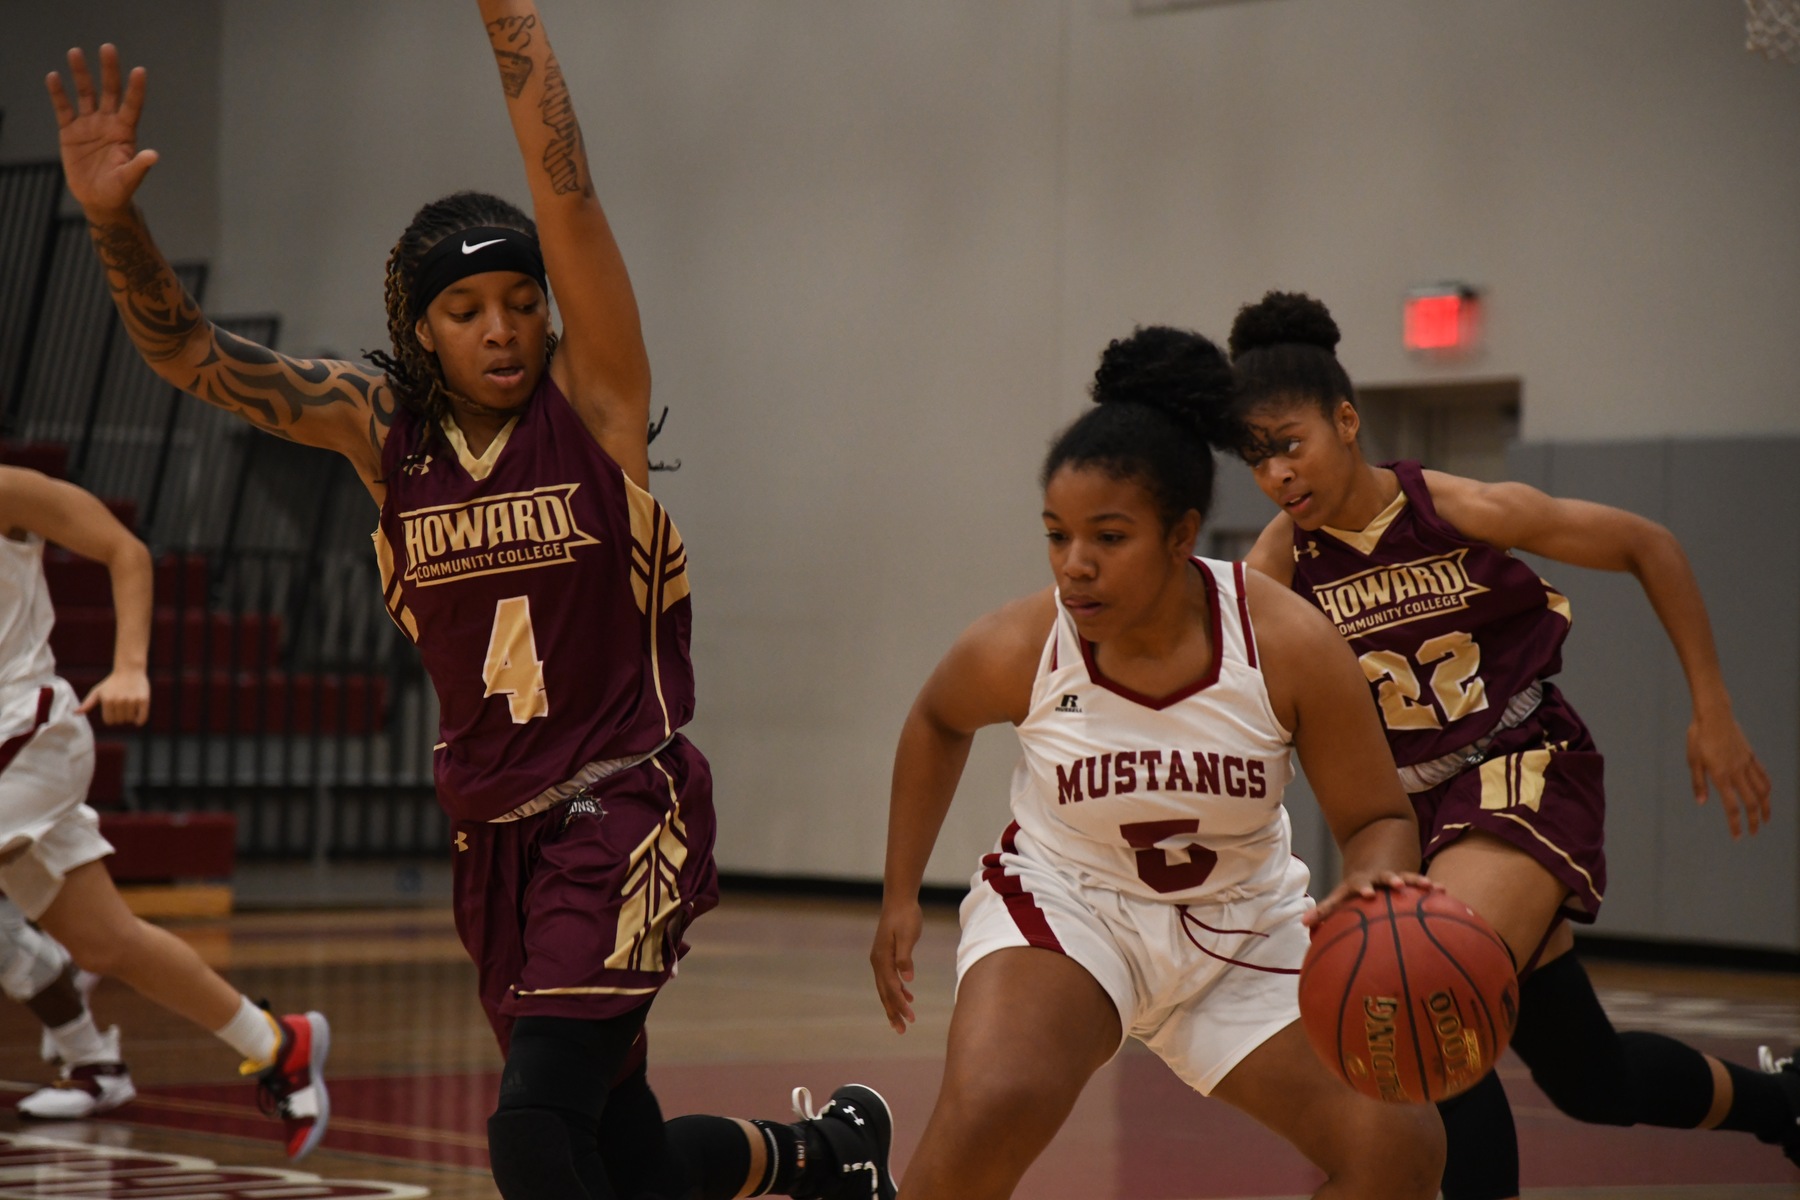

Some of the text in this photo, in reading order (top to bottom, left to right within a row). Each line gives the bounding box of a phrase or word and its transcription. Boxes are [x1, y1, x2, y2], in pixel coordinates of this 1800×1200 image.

[403, 495, 571, 566] HOWARD
[417, 542, 563, 580] COMMUNITY COLLEGE
[1316, 560, 1465, 625] HOWARD
[1338, 594, 1460, 636] OMMUNITY COLLEGE
[482, 595, 549, 725] 4
[1358, 630, 1490, 731] 22
[1056, 750, 1267, 806] MUSTANGS
[1119, 818, 1219, 894] 5
